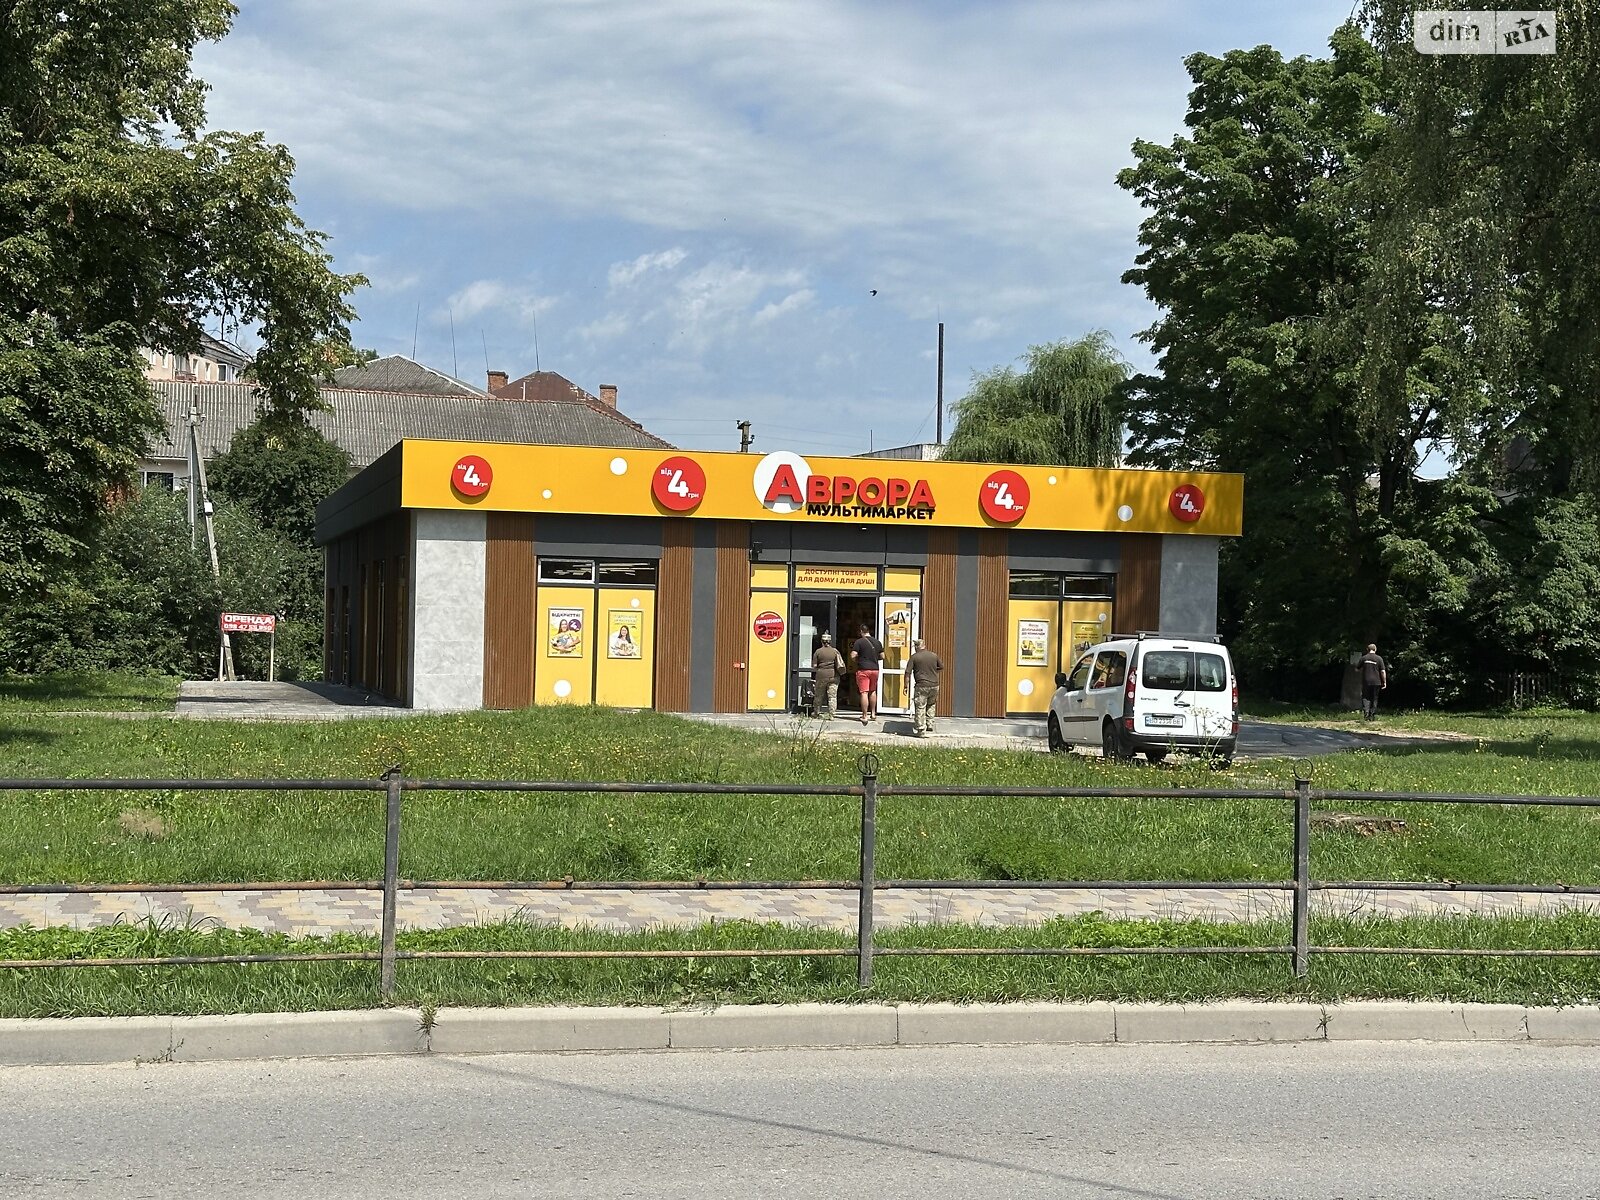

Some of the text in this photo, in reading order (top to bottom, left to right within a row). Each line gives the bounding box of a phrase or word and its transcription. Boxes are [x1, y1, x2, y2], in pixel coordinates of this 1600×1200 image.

[463, 465, 480, 486] 4
[660, 467, 673, 476] від
[668, 469, 689, 497] 4
[987, 481, 999, 489] від
[994, 482, 1015, 510] 4
[1180, 493, 1194, 513] 4
[806, 504, 936, 520] МУЛЬТИМАРКЕТ
[804, 568, 840, 576] ДОСТУПНІ
[224, 615, 272, 625] ОРЕНДА
[757, 625, 767, 636] 2
